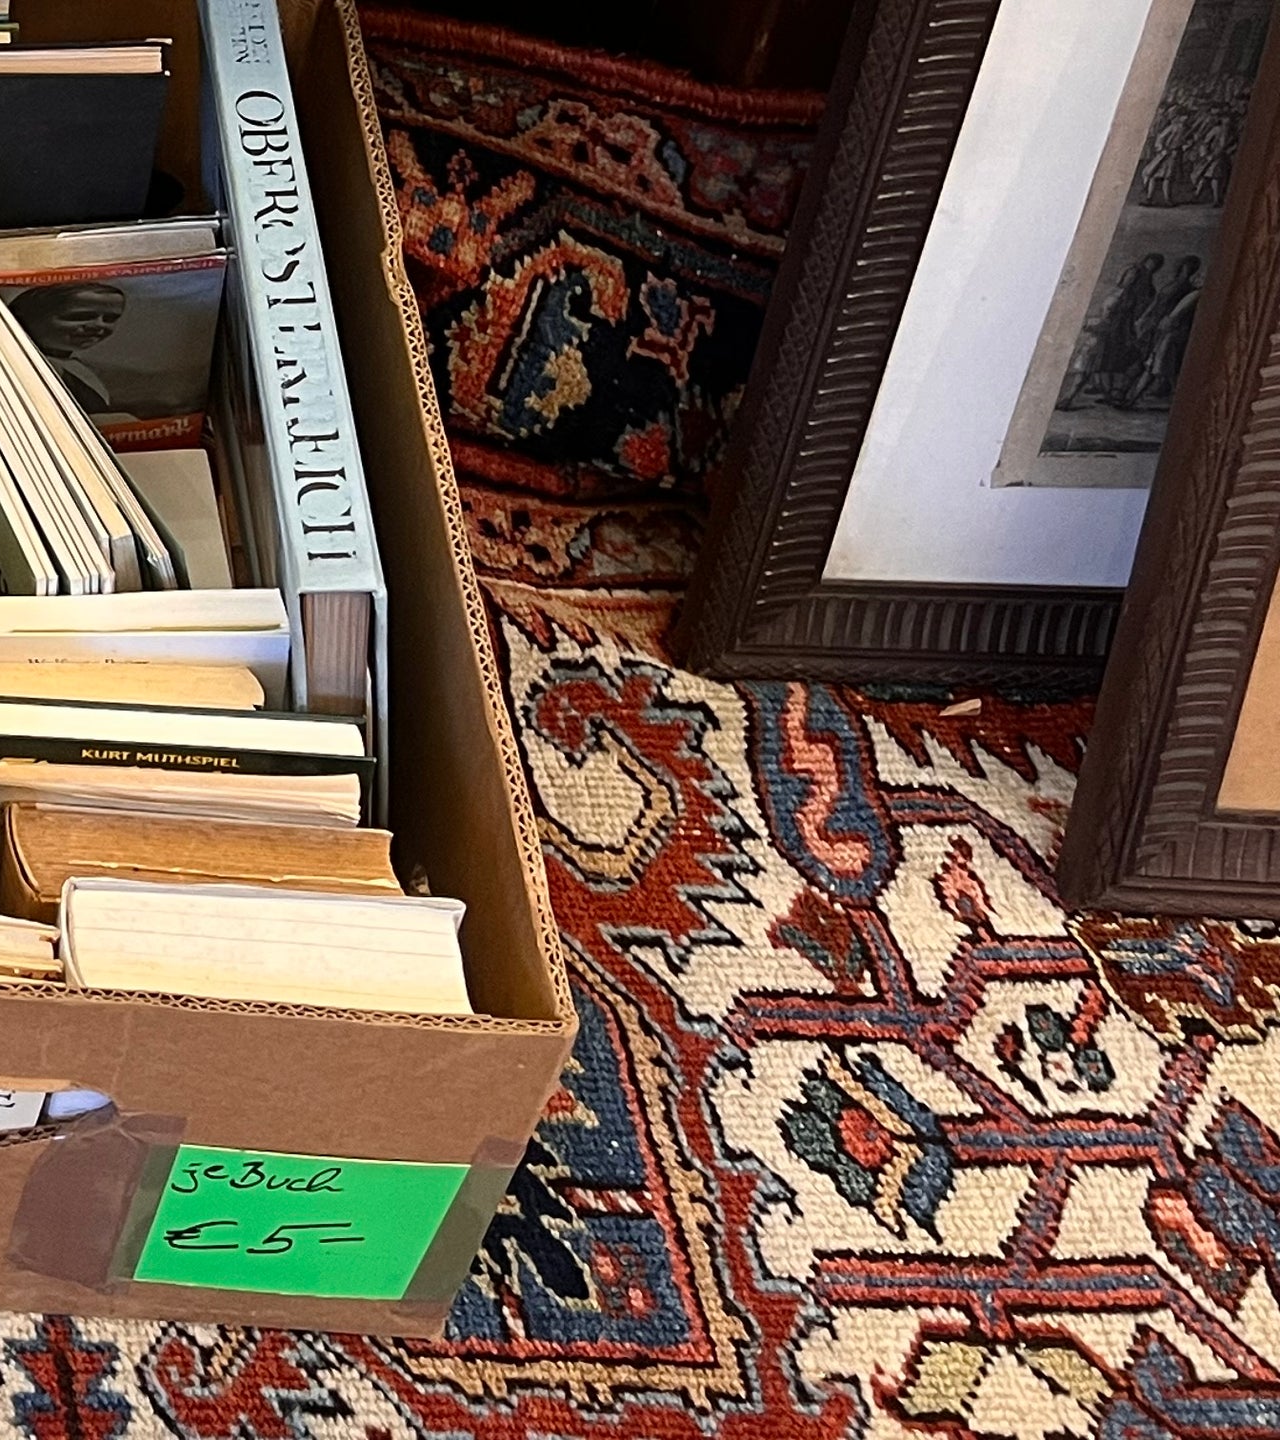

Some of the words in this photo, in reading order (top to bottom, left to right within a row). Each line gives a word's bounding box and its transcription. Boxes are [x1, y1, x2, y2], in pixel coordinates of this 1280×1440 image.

[81, 748, 131, 761] KURT
[136, 750, 240, 768] MUTHSPIEL
[171, 1163, 229, 1192] je
[229, 1161, 344, 1192] Buch
